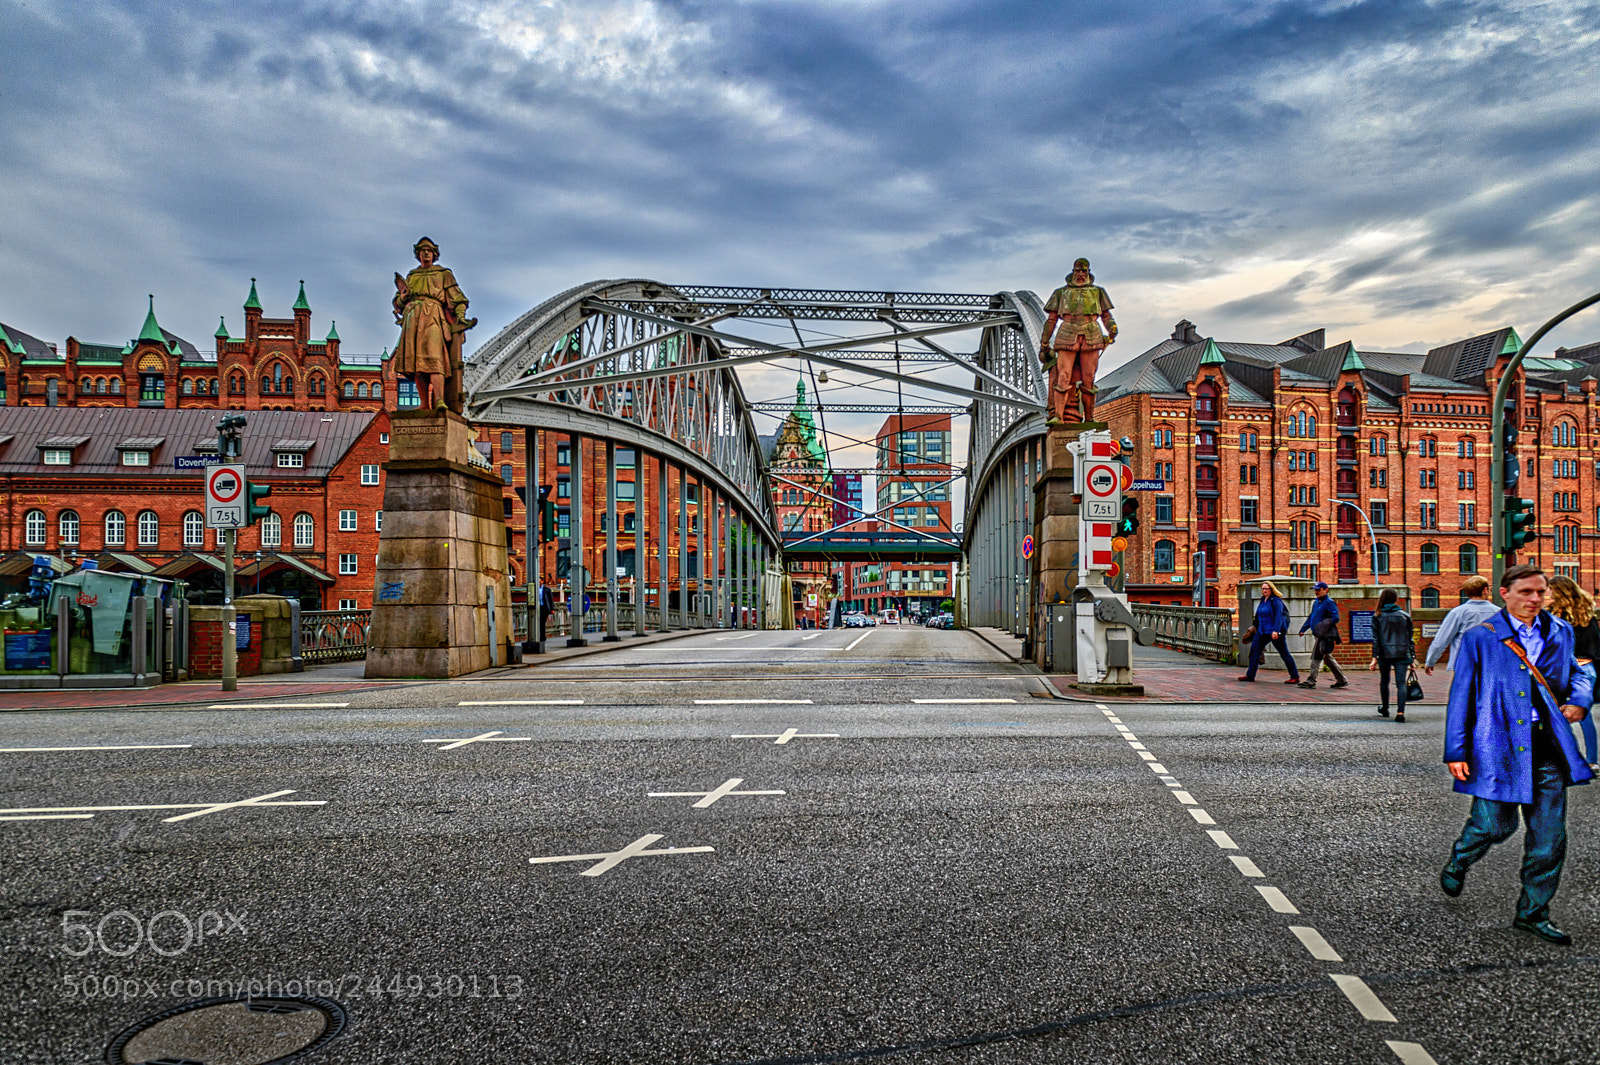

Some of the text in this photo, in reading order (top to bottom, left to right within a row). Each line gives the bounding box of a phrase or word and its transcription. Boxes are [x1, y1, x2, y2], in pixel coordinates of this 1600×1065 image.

[395, 426, 444, 435] COLUMBUS
[178, 457, 220, 467] Dovenfleet
[1131, 481, 1162, 490] ippelhaus
